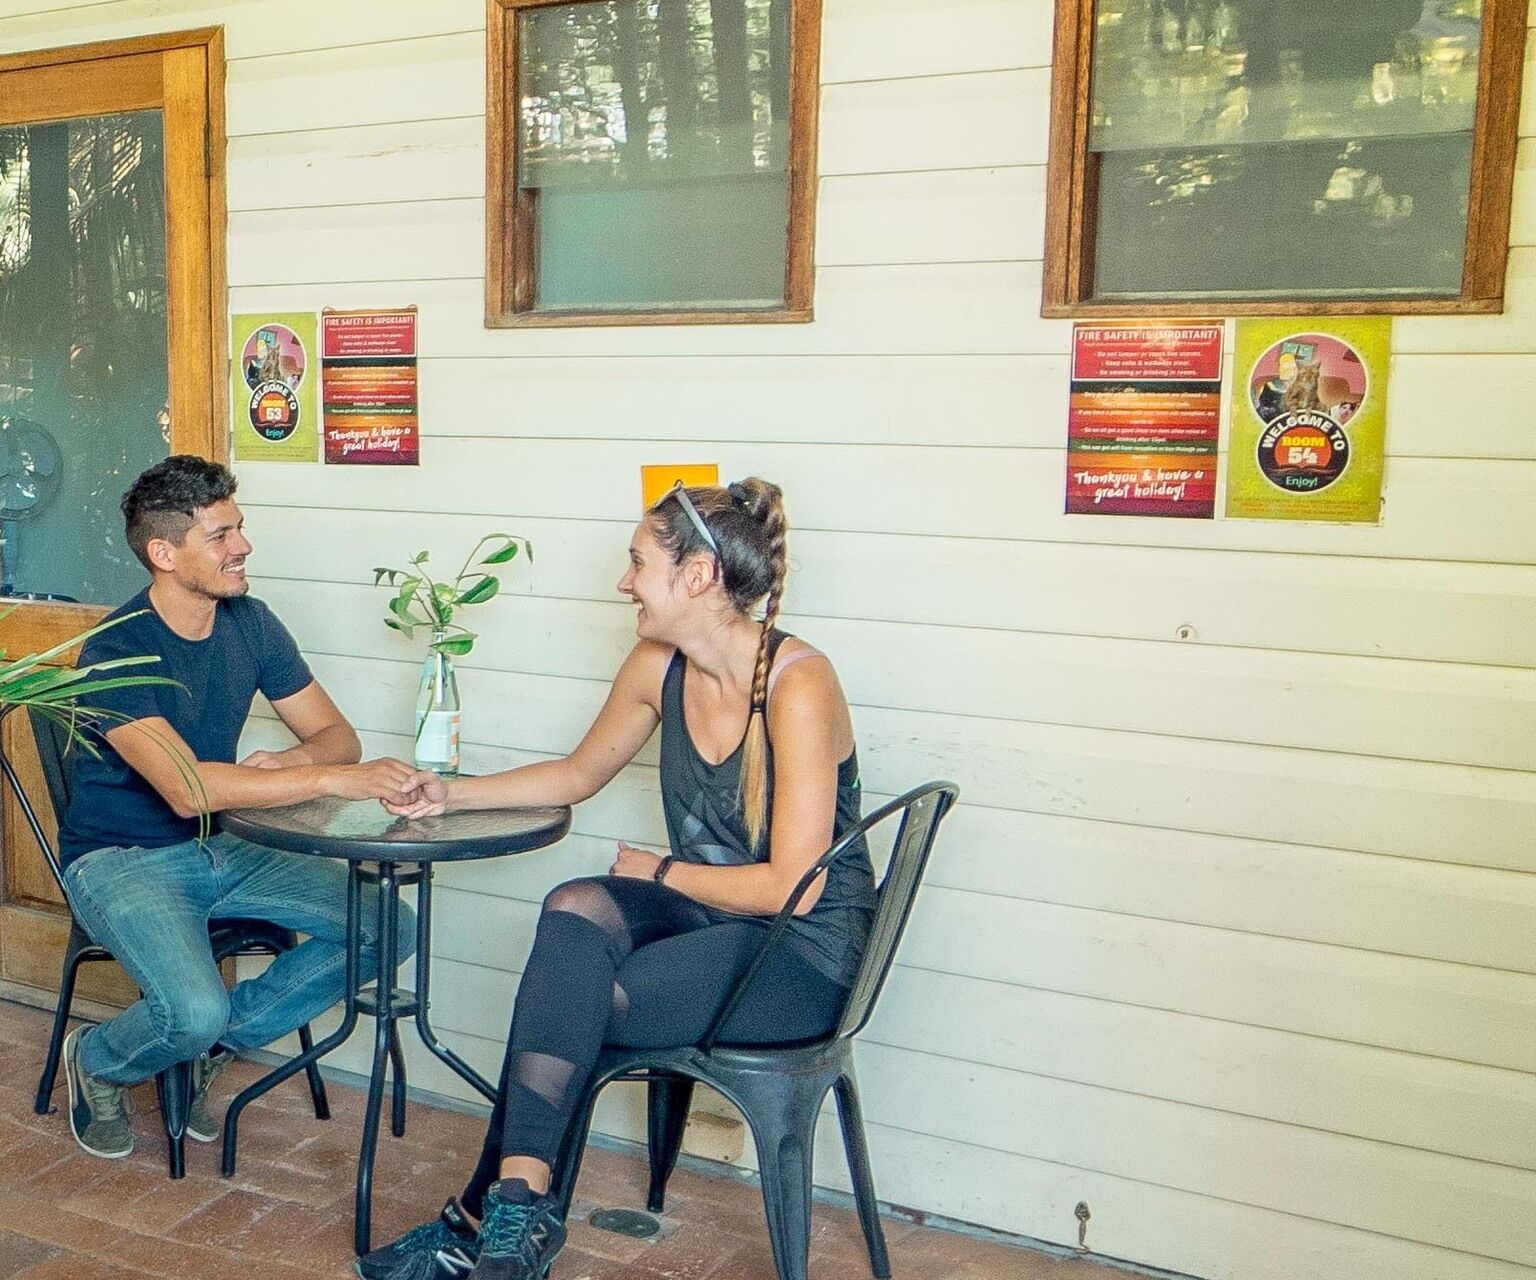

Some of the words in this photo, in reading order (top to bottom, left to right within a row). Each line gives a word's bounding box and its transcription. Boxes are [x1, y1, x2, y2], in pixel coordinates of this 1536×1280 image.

[1078, 330, 1101, 340] FIRE
[1104, 330, 1139, 340] SAFETY
[1156, 329, 1218, 340] IMPORTANT!
[251, 383, 289, 409] WELCOME
[287, 394, 297, 410] TO
[266, 407, 282, 420] 53
[381, 425, 404, 437] have
[1262, 414, 1333, 448] WELCOME
[1330, 429, 1345, 451] TO
[342, 439, 365, 456] great
[367, 436, 401, 452] holiday!
[1282, 436, 1326, 447] ROOM
[1287, 446, 1318, 465] 54
[1074, 470, 1138, 488] Thankyou
[1142, 468, 1152, 481] &
[1157, 467, 1192, 481] have
[1193, 470, 1204, 480] a
[1285, 475, 1318, 488] Enjoy!
[1094, 483, 1132, 504] great
[1134, 481, 1186, 501] holiday!
